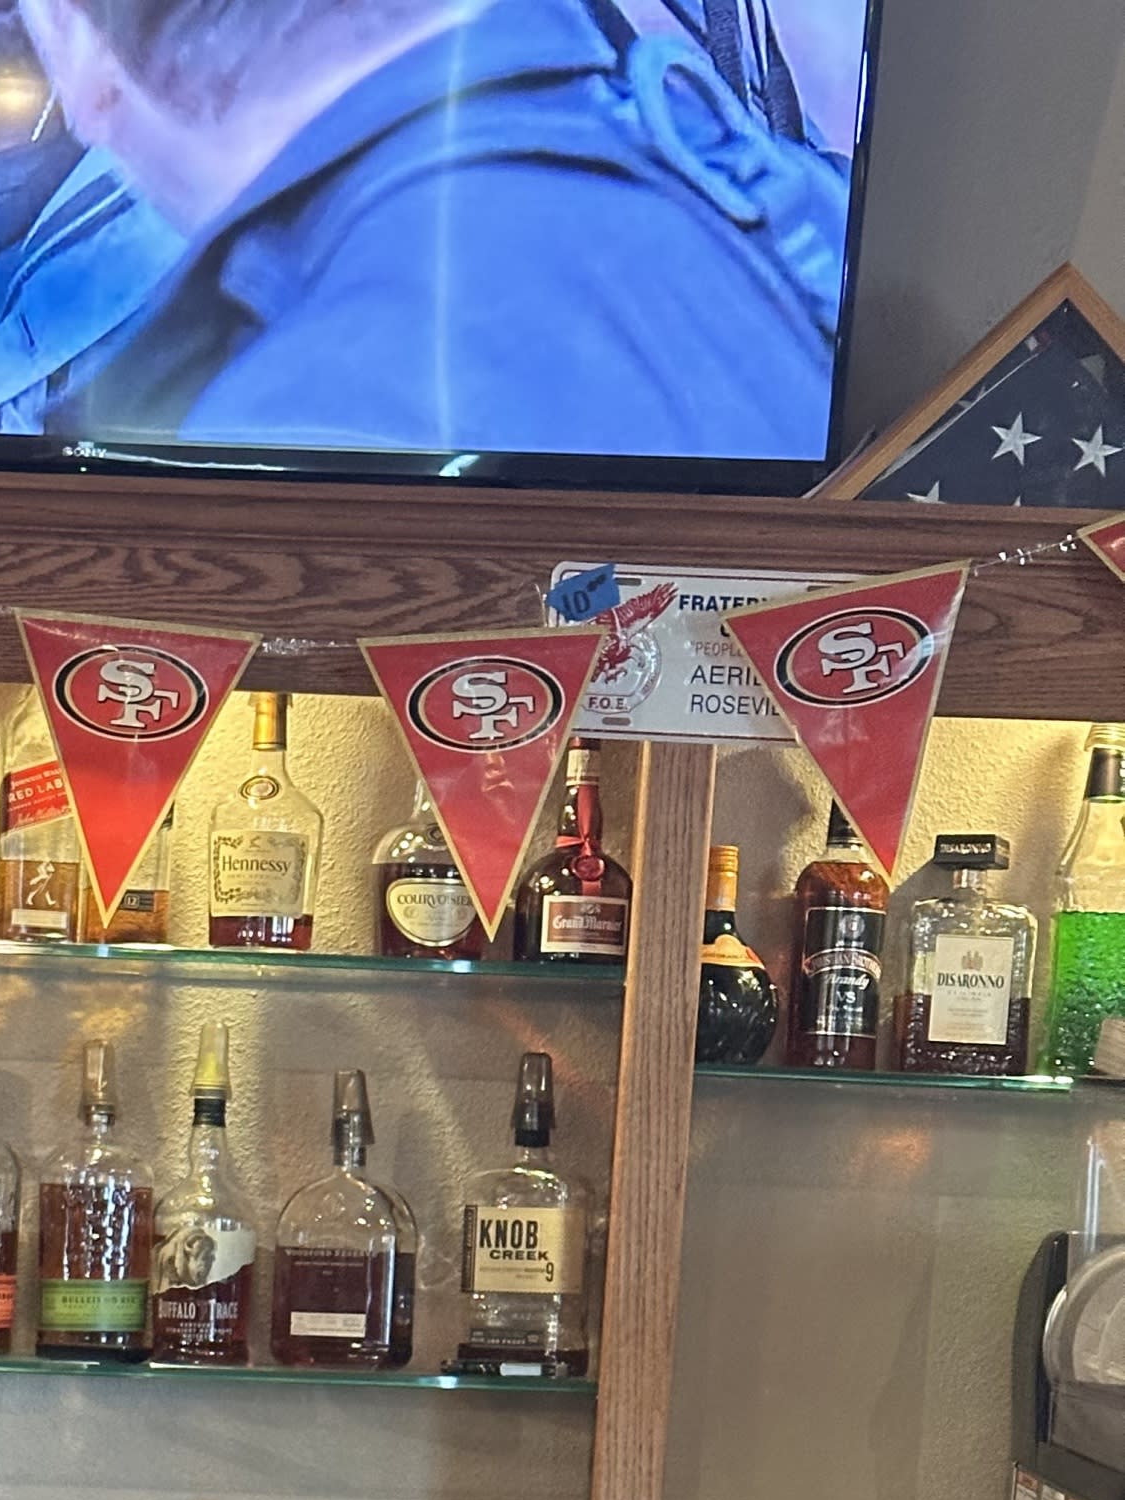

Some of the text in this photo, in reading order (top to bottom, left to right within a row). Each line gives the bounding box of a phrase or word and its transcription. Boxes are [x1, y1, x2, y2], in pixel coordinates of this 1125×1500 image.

[678, 594, 768, 611] FRATER
[8, 788, 33, 803] RED
[222, 855, 291, 876] Hennessy
[937, 972, 1005, 989] DISARONNO
[479, 1219, 539, 1249] KNOB
[489, 1249, 549, 1261] CREEK
[546, 1262, 555, 1282] 9
[158, 1298, 239, 1320] BUFFALO TRACE
